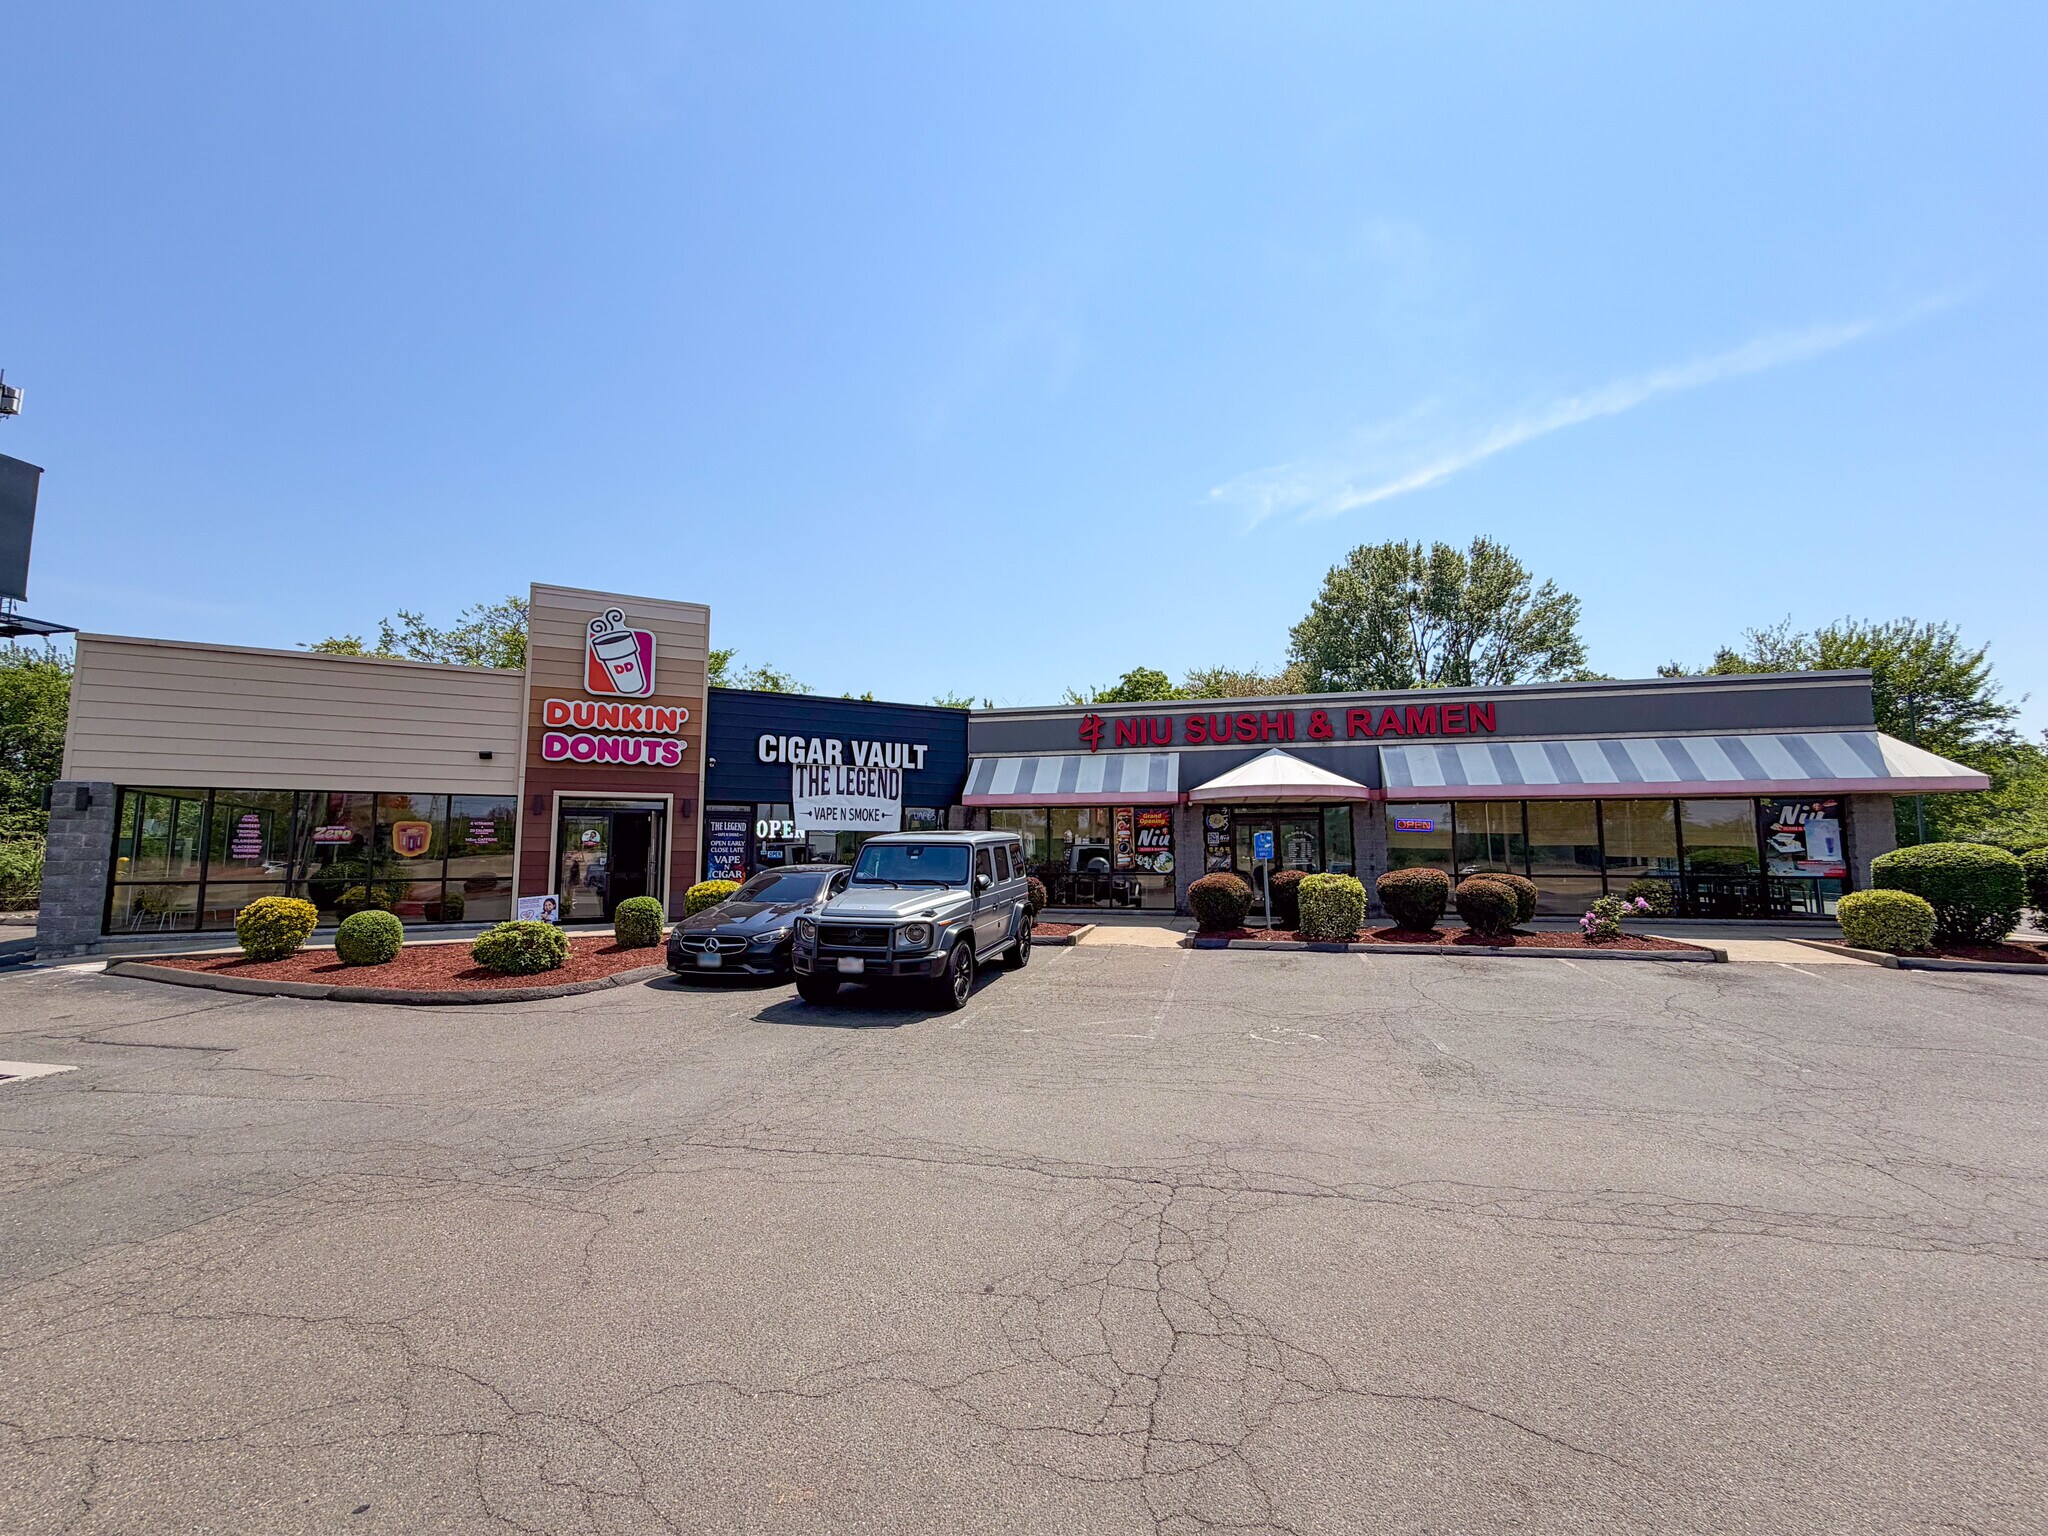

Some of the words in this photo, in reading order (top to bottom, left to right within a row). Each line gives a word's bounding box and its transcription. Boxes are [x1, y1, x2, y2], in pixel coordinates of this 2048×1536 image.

[613, 662, 634, 675] DD
[546, 701, 687, 733] DUNKIN'
[1114, 717, 1173, 746] NIU
[1184, 710, 1295, 743] SUSHI
[1307, 709, 1335, 739] &
[1346, 702, 1497, 738] RAMEN
[544, 734, 680, 765] DONUTS
[758, 734, 843, 766] CIGAR
[851, 740, 928, 770] VAULT
[795, 764, 831, 798] THE
[836, 766, 899, 801] LEGEND
[814, 806, 838, 820] VAPE
[840, 807, 847, 821] N
[849, 808, 880, 822] SMOKE
[313, 826, 352, 840] Zero
[710, 822, 724, 832] THE
[724, 822, 747, 832] LEGEND
[1397, 820, 1431, 830] OPEN
[1137, 828, 1171, 846] Niu
[714, 855, 741, 864] VAPE
[711, 870, 743, 879] CIGAR
